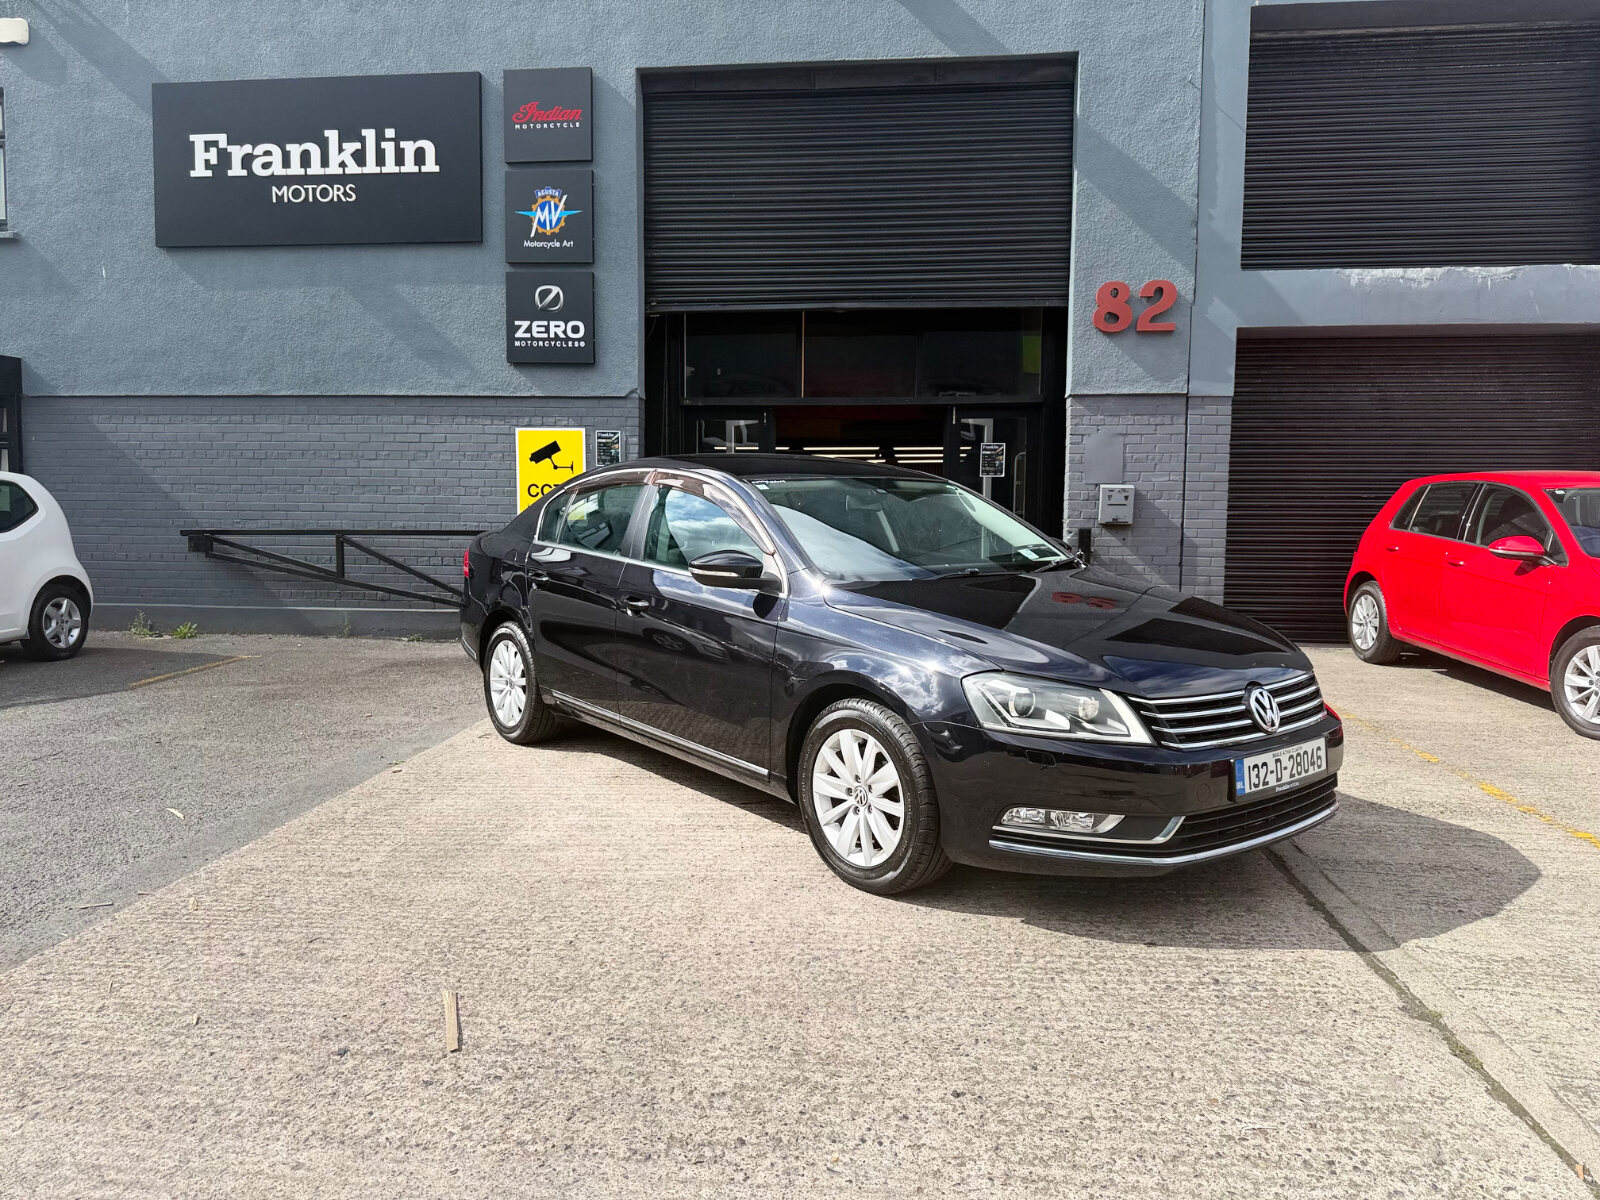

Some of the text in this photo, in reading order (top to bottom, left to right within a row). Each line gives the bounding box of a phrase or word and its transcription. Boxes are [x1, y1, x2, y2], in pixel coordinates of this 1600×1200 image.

[512, 101, 583, 123] Indian
[515, 122, 580, 130] MOTORCYCLE
[189, 128, 440, 178] Franklin
[271, 184, 357, 203] MOTORS
[530, 194, 568, 238] MV
[523, 239, 574, 249] Motorcycle Art
[1092, 279, 1178, 333] 82
[514, 320, 585, 339] ZERO
[527, 483, 561, 498] CC
[1247, 745, 1323, 790] 132-D-28046
